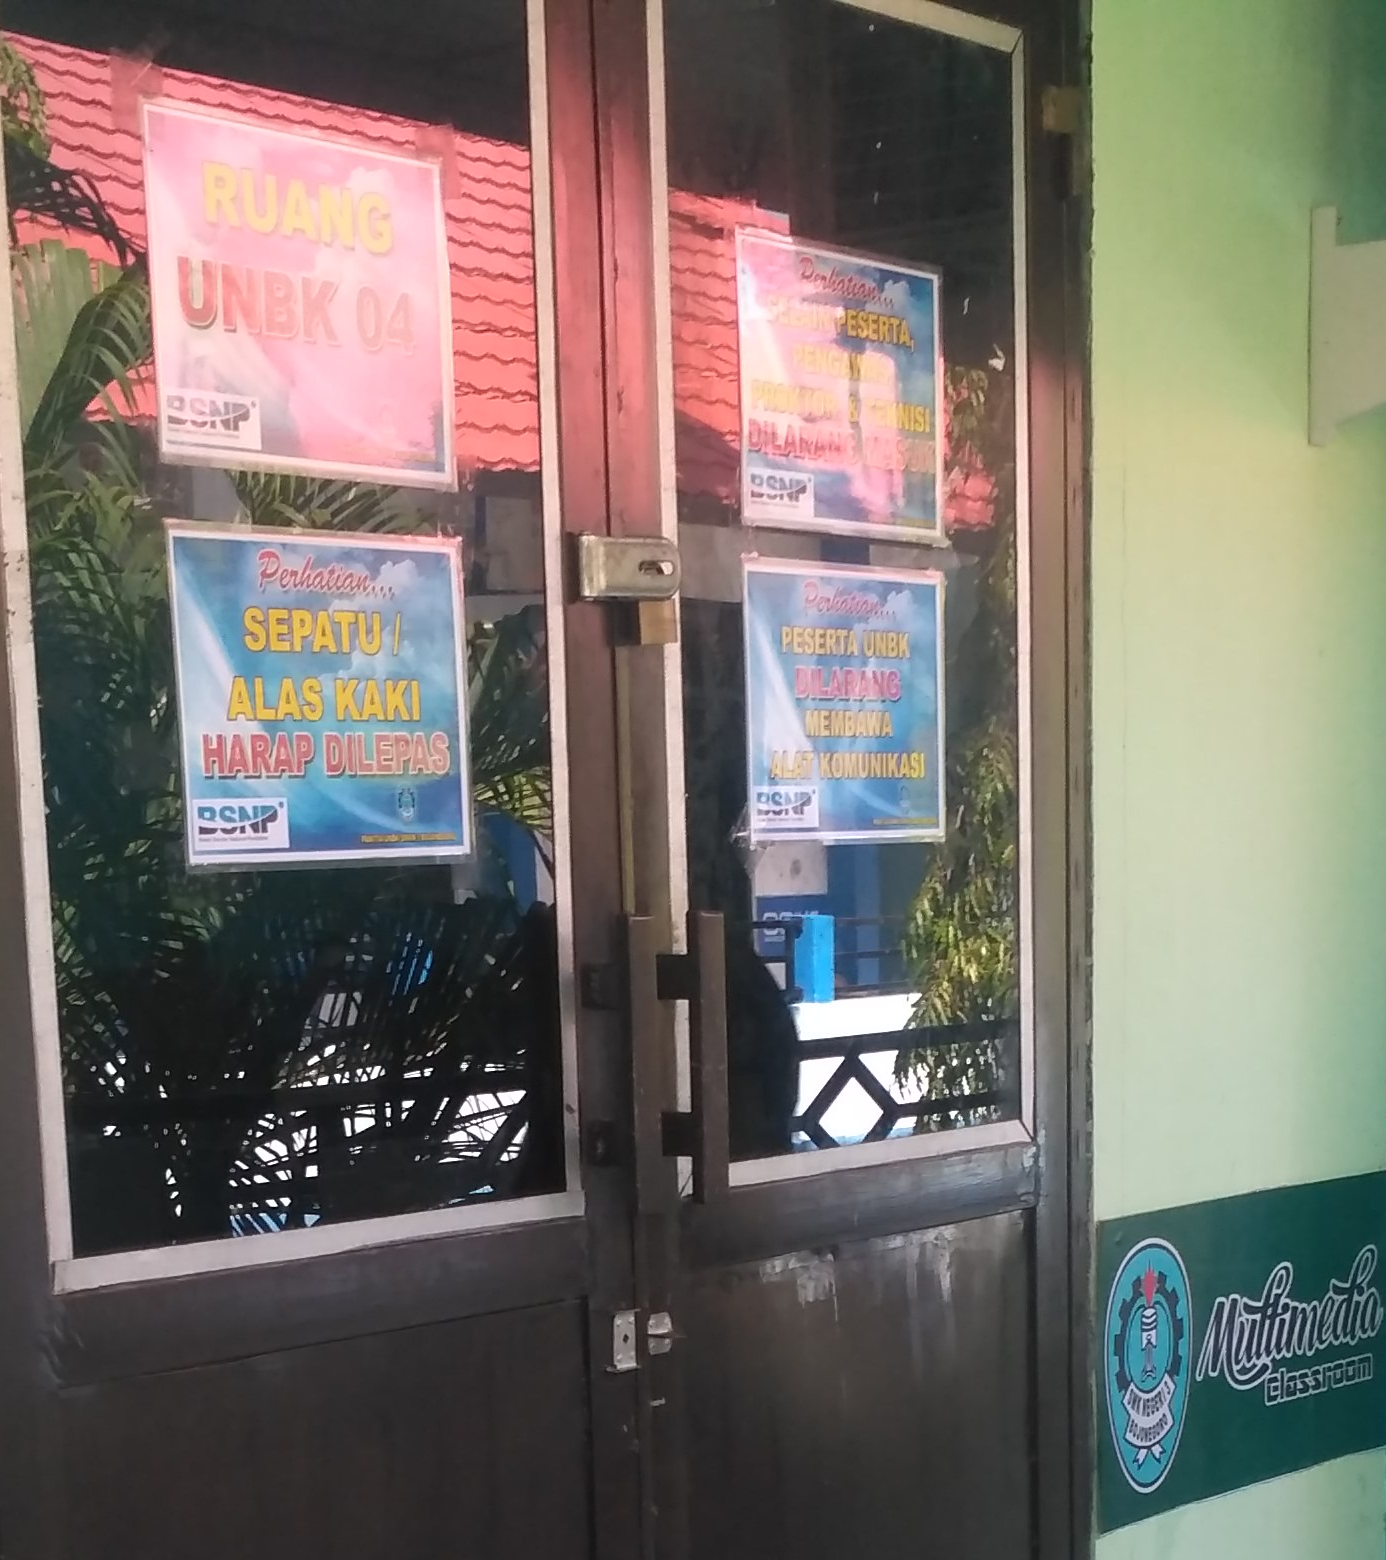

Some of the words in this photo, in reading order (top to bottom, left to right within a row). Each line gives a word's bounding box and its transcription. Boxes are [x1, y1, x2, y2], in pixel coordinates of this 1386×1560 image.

[203, 160, 394, 255] RUANG
[177, 256, 341, 347] UNBK
[356, 286, 416, 355] 04
[166, 395, 250, 432] BSNP
[748, 418, 861, 464] DILARANG
[750, 473, 807, 503] BSNP
[243, 607, 381, 656] SEPATU
[781, 626, 858, 656] PESERTA
[862, 630, 910, 658] UNBK
[227, 676, 323, 722] ALAS
[335, 677, 422, 722] KAKI
[794, 665, 901, 700] DILARANG
[804, 709, 893, 738] MEMBAWA
[201, 731, 314, 779] HARAP
[324, 731, 451, 778] DILEPAS
[770, 750, 814, 780] ALAT
[819, 751, 926, 780] KOMUNIKASI
[197, 805, 278, 836] BSNP
[757, 791, 812, 817] BSNP
